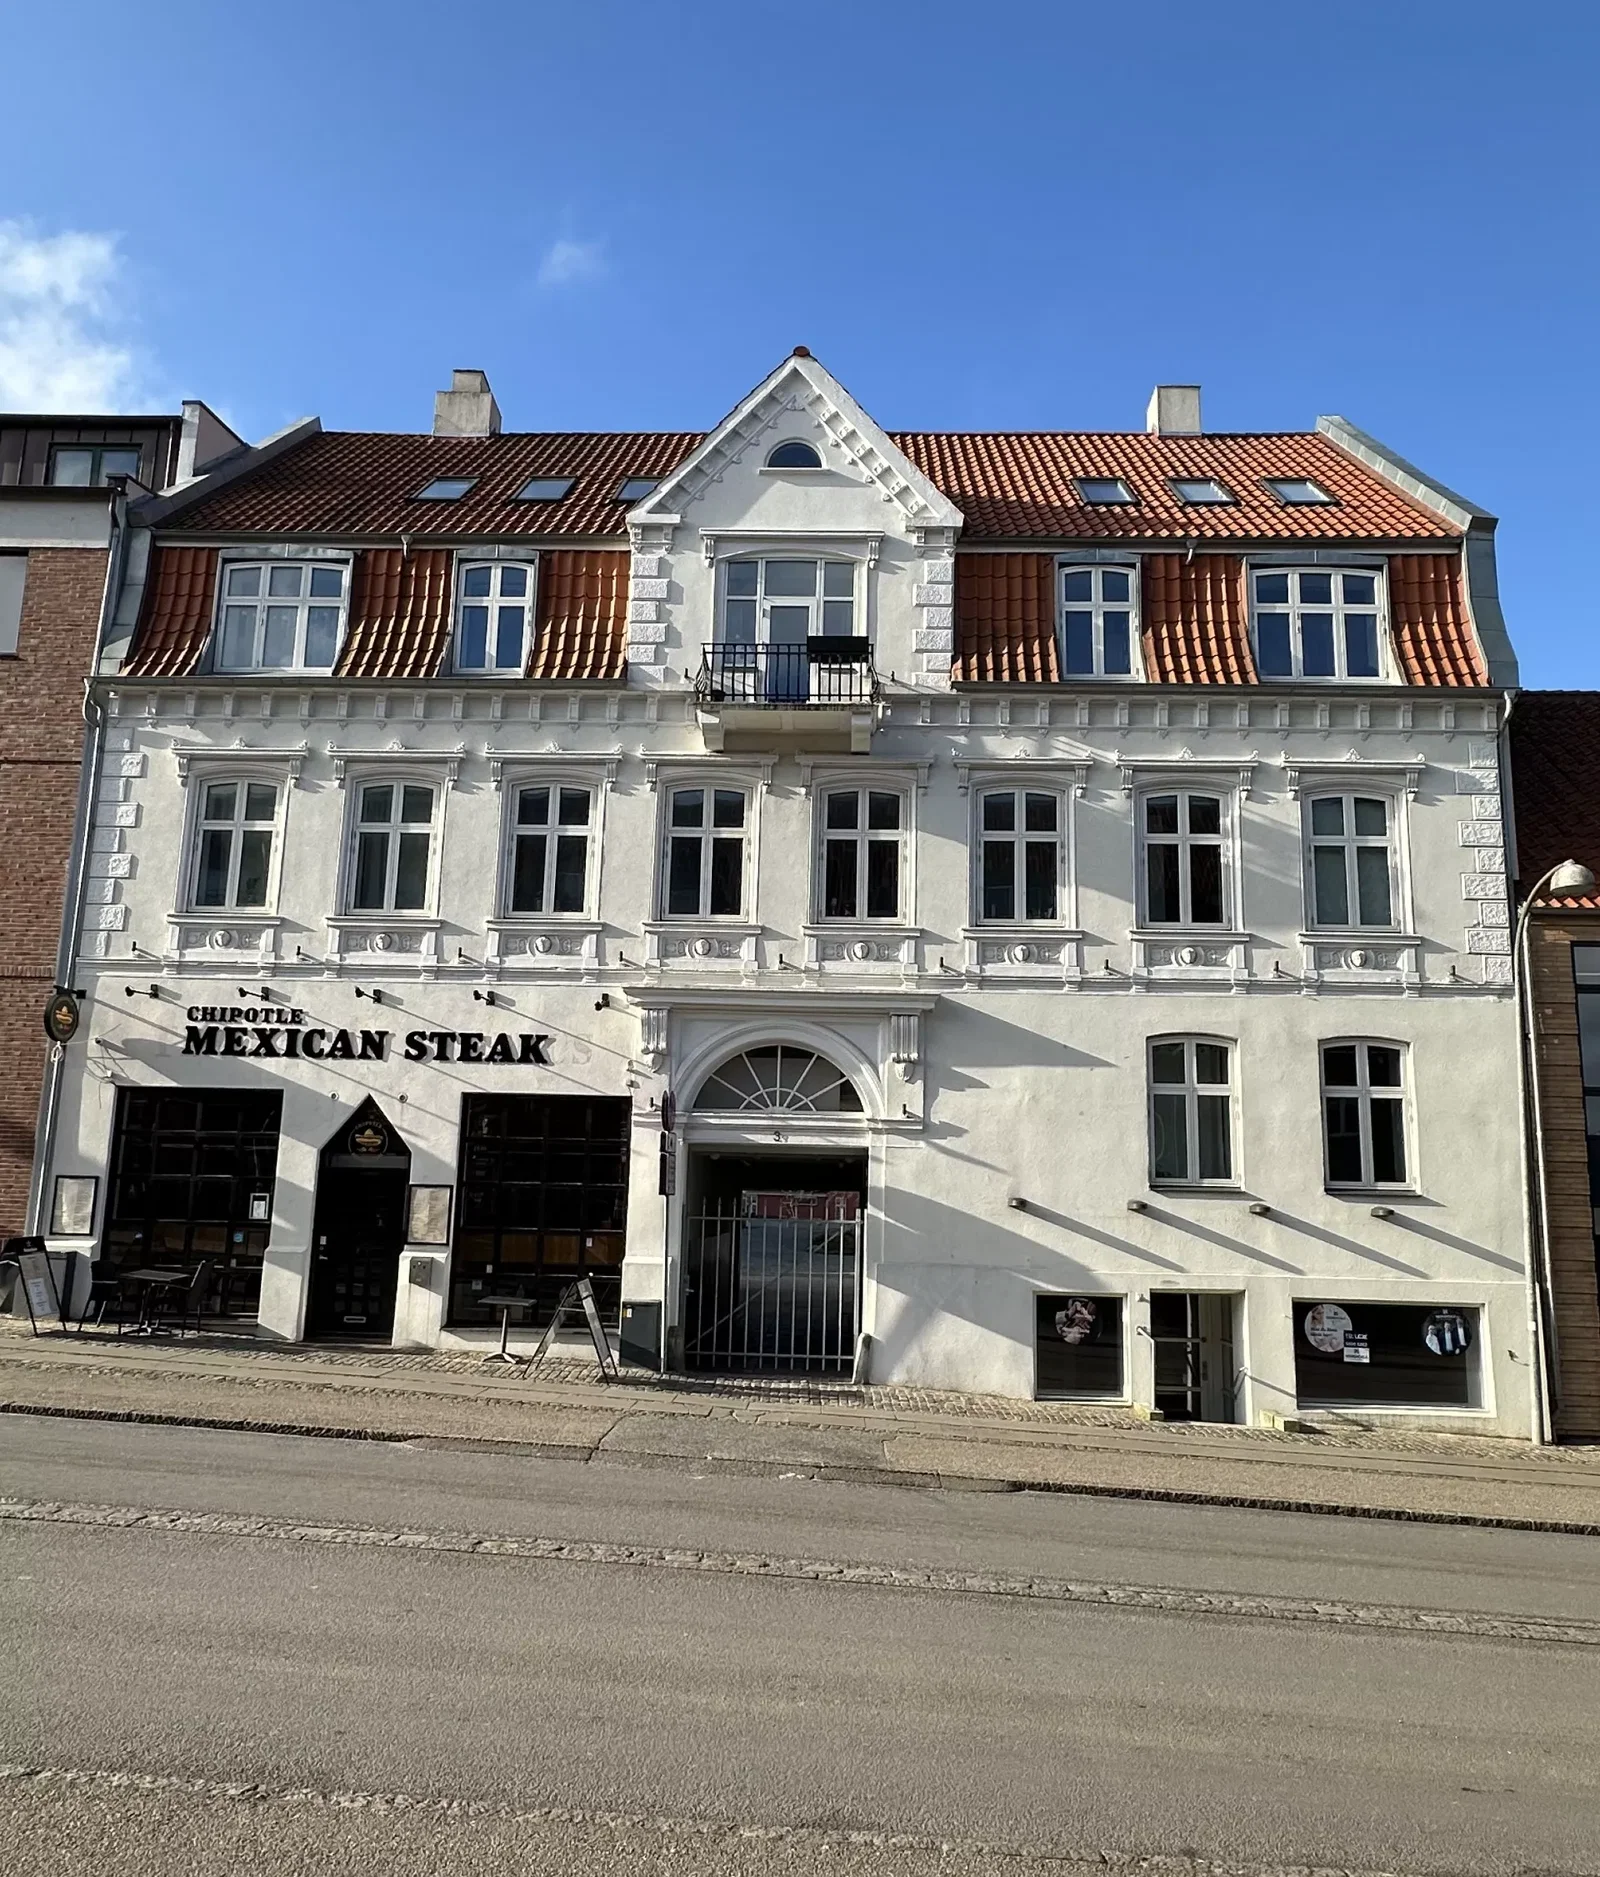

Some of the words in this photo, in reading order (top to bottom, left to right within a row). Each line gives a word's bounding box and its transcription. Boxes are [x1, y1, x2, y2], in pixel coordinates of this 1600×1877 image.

[187, 1005, 305, 1025] CHIPOTLE
[181, 1025, 388, 1060] MEXICAN
[404, 1030, 549, 1065] STEAK
